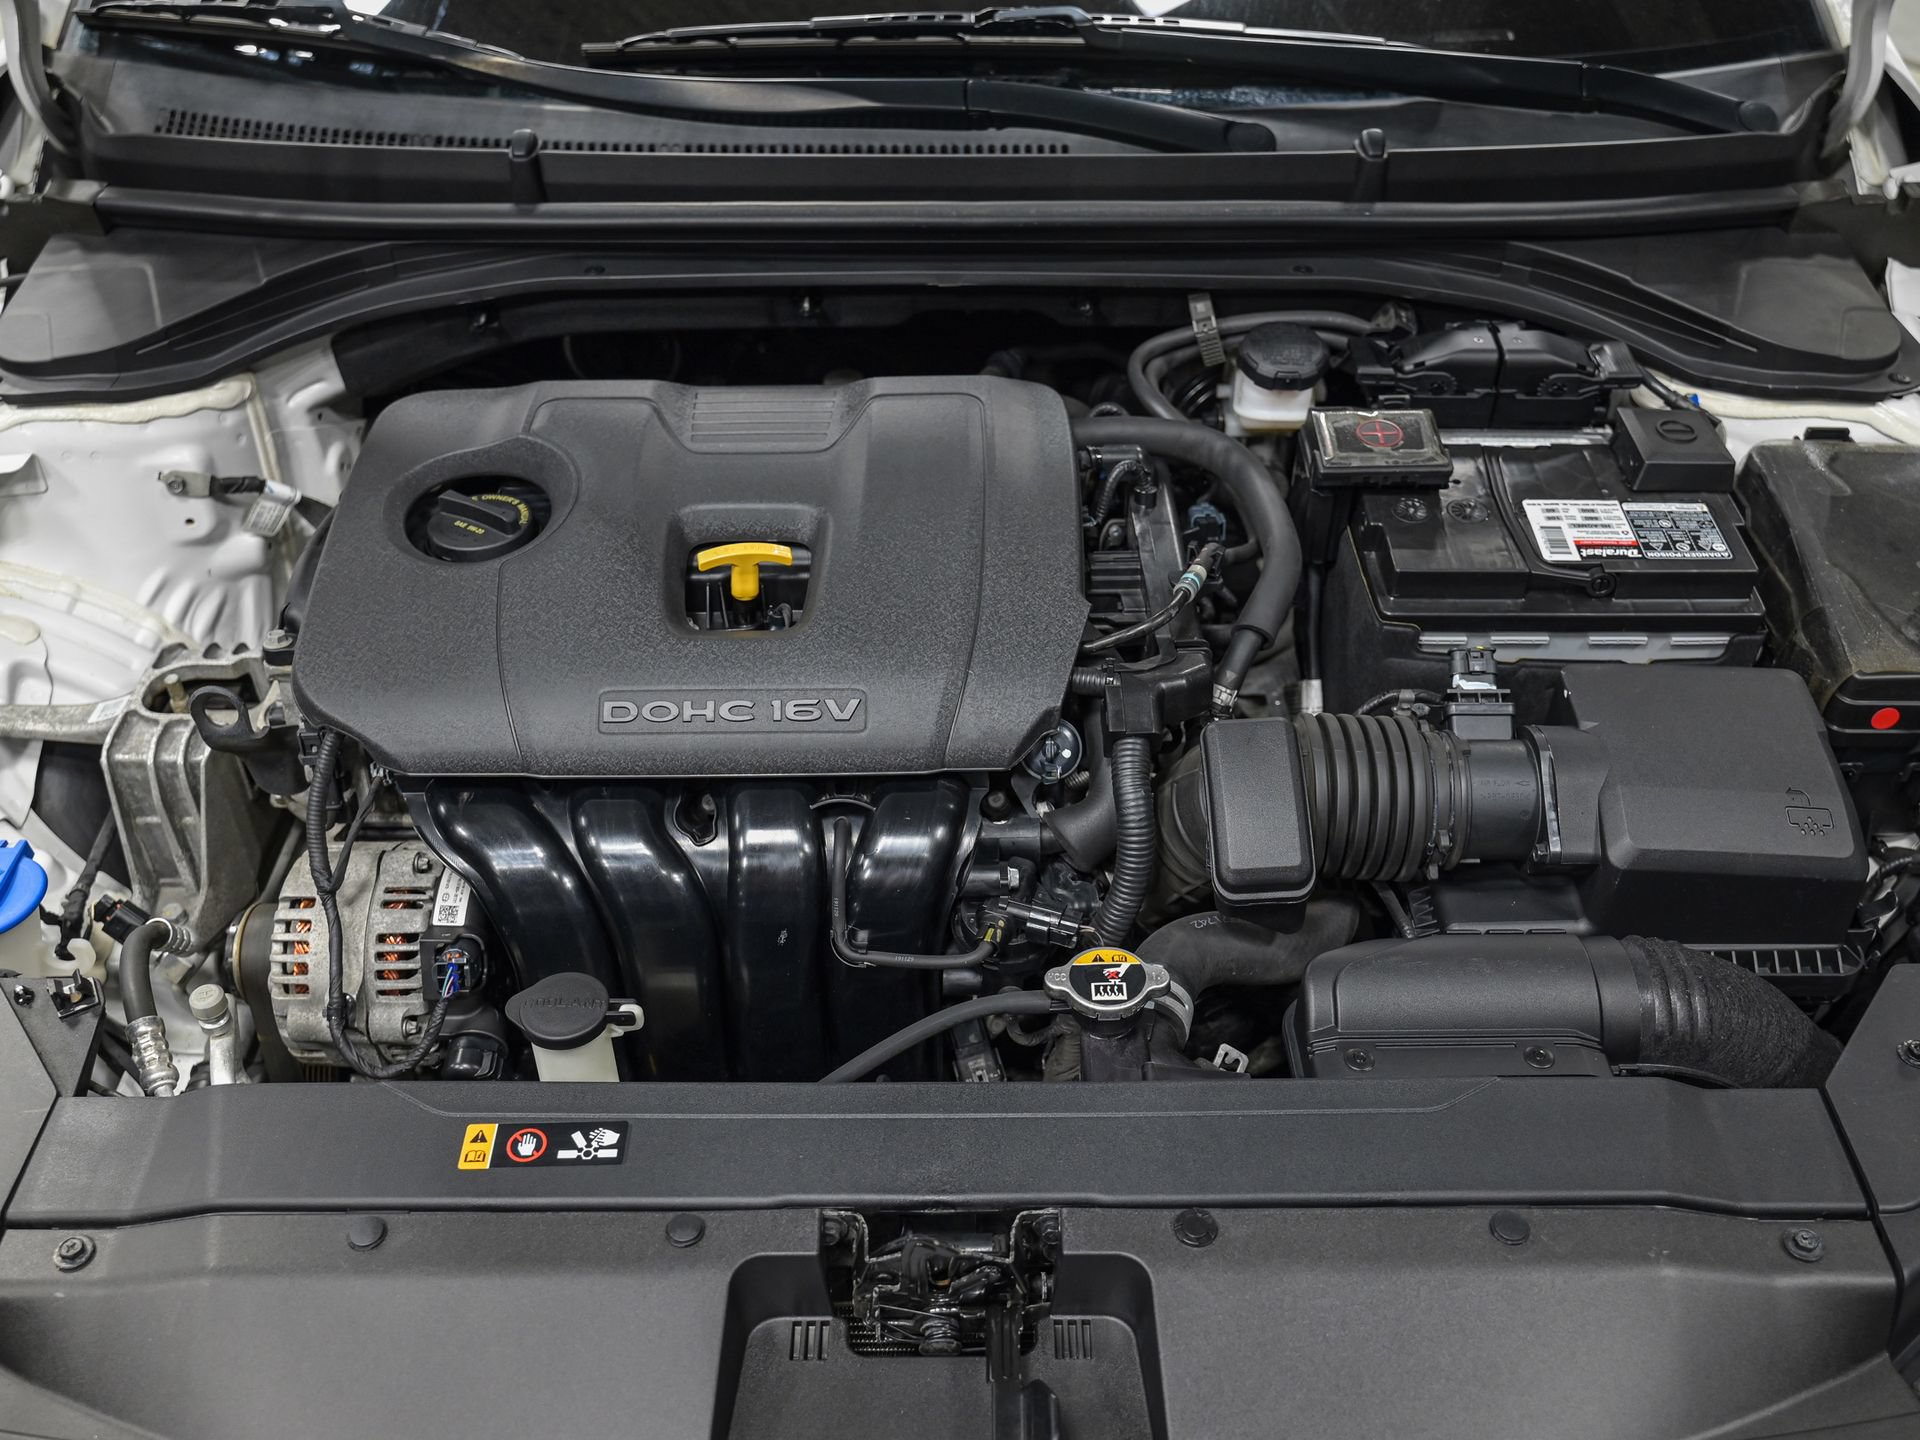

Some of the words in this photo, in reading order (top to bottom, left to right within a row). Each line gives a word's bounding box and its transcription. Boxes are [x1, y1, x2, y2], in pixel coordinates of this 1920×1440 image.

[1580, 548, 1642, 558] Duralast
[602, 700, 756, 723] DOHC
[771, 698, 862, 722] 16V
